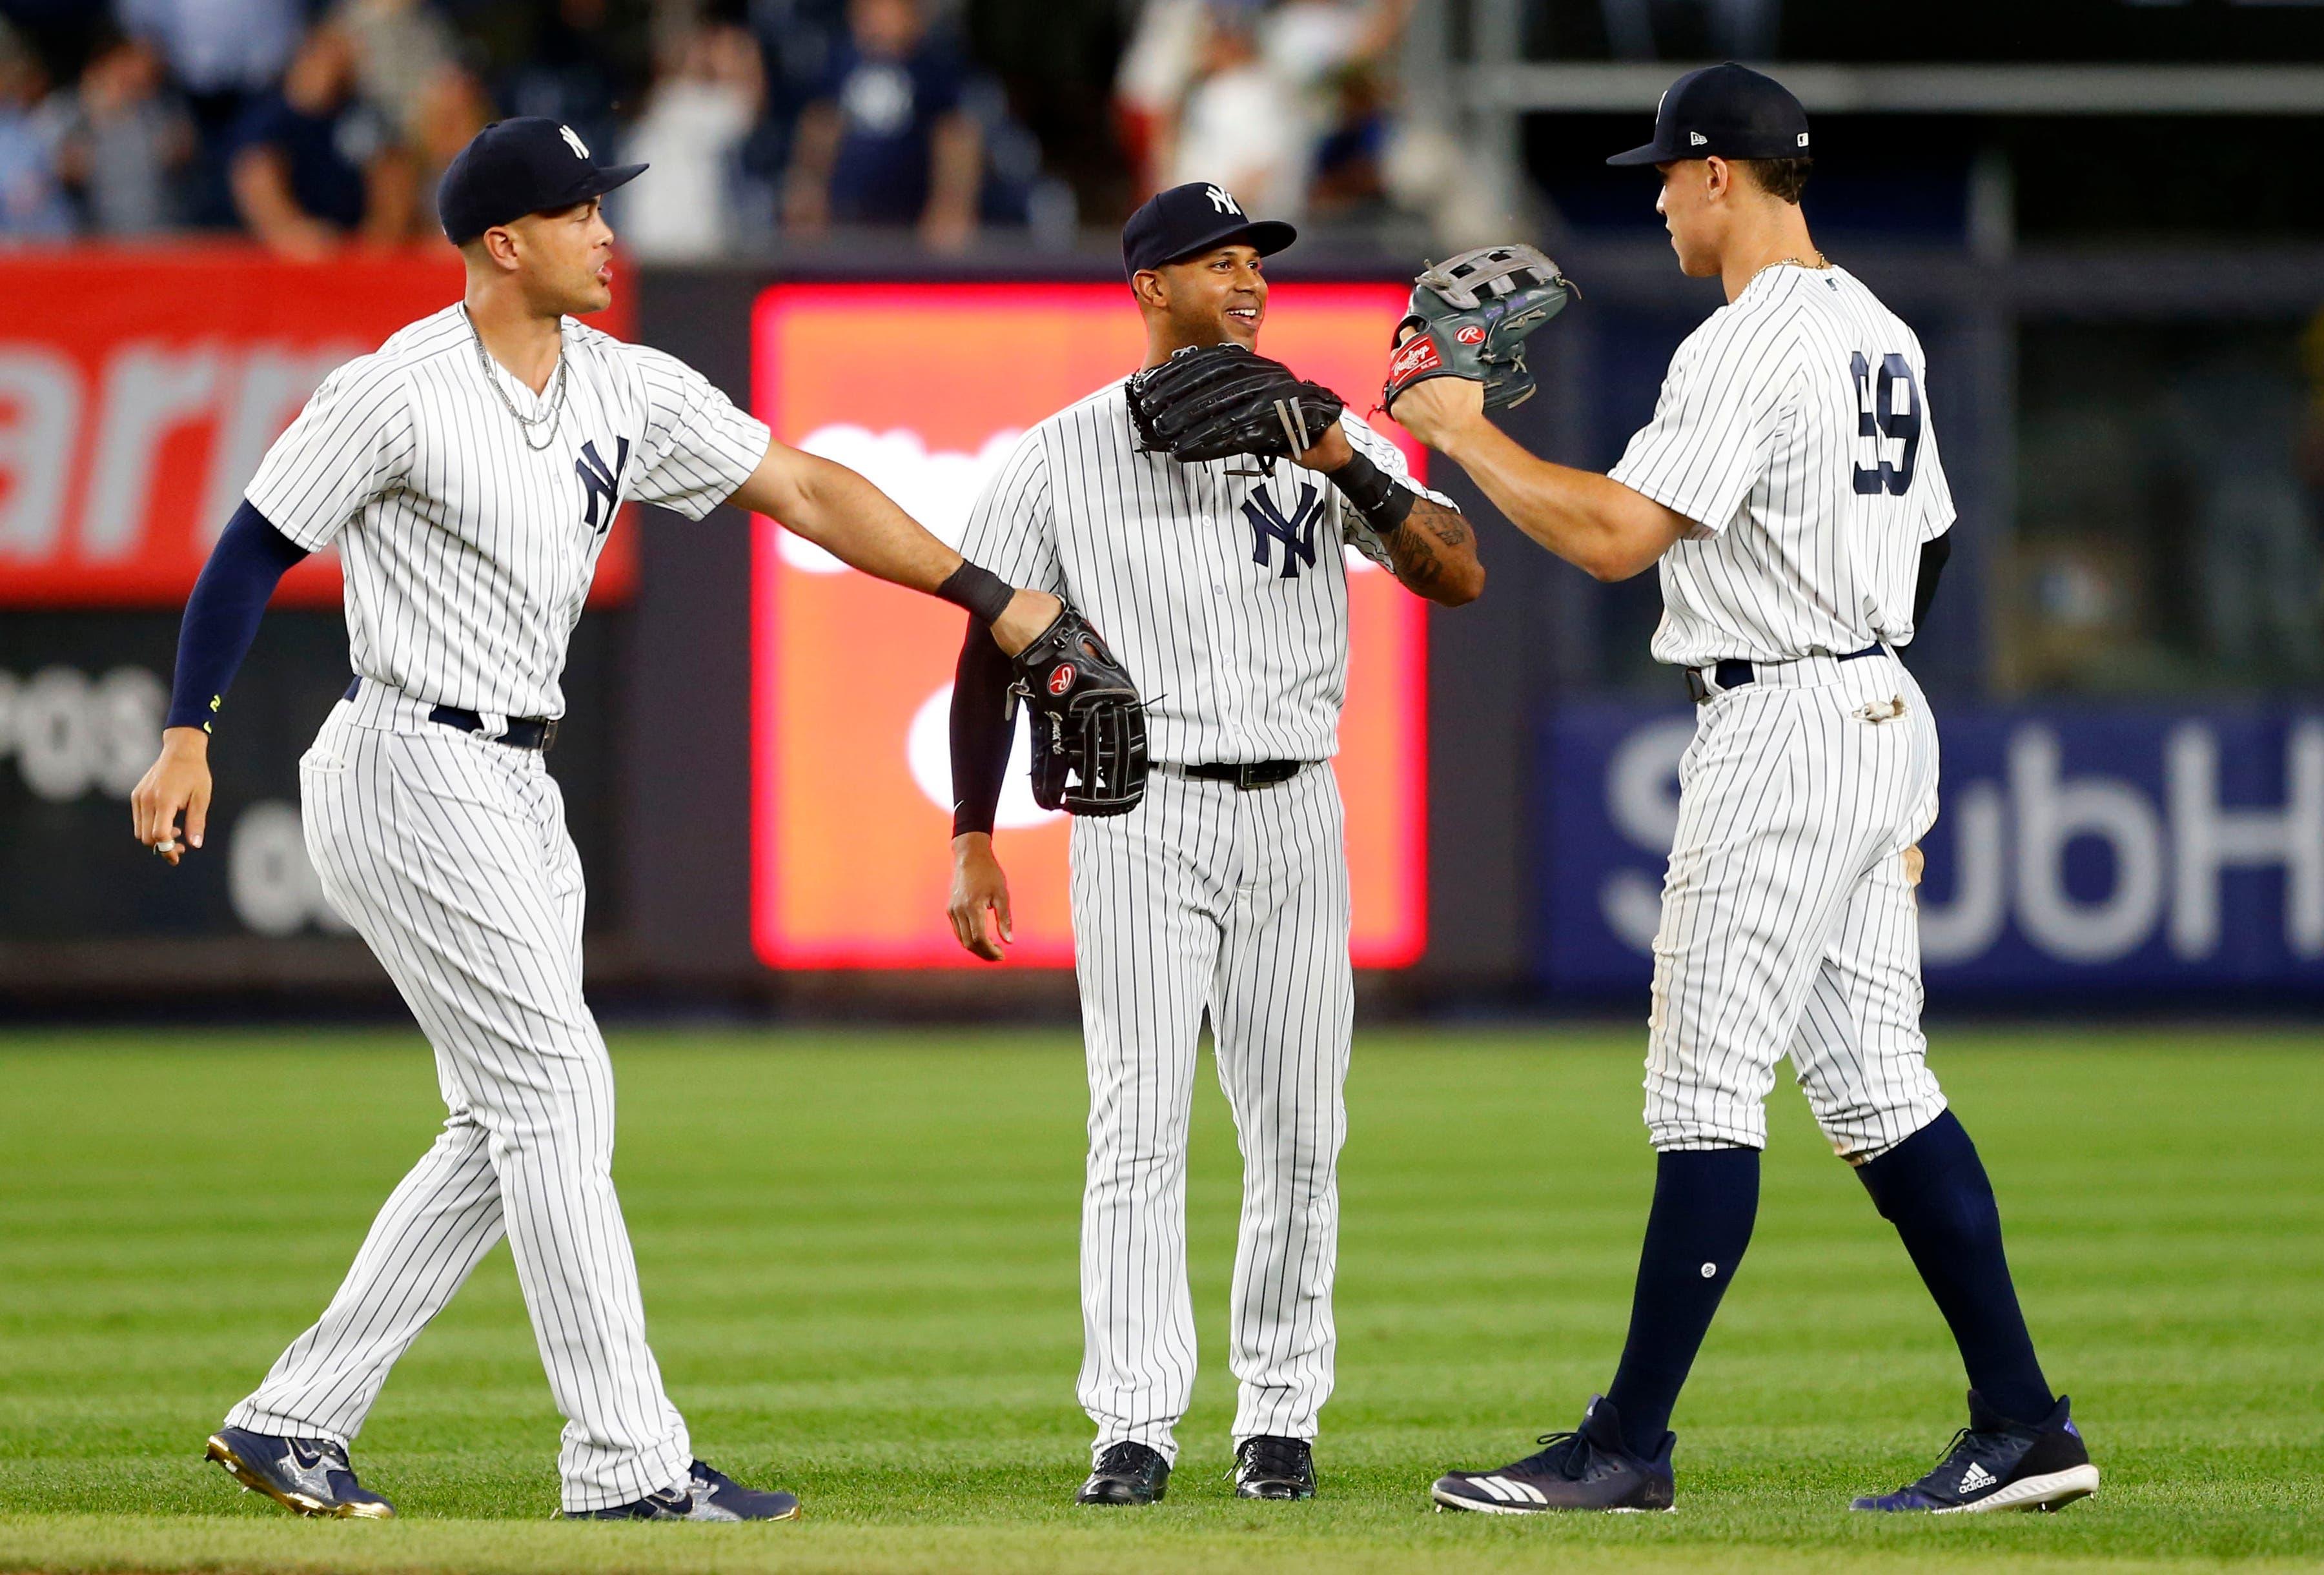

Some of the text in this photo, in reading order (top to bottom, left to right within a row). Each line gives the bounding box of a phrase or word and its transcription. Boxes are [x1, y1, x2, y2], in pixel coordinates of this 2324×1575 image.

[1205, 185, 1241, 216] NY
[1394, 345, 1430, 377] Rawlings
[1850, 351, 1921, 496] 99
[575, 435, 630, 535] NY
[1240, 482, 1325, 578] NY
[1959, 1476, 1997, 1494] adidas
